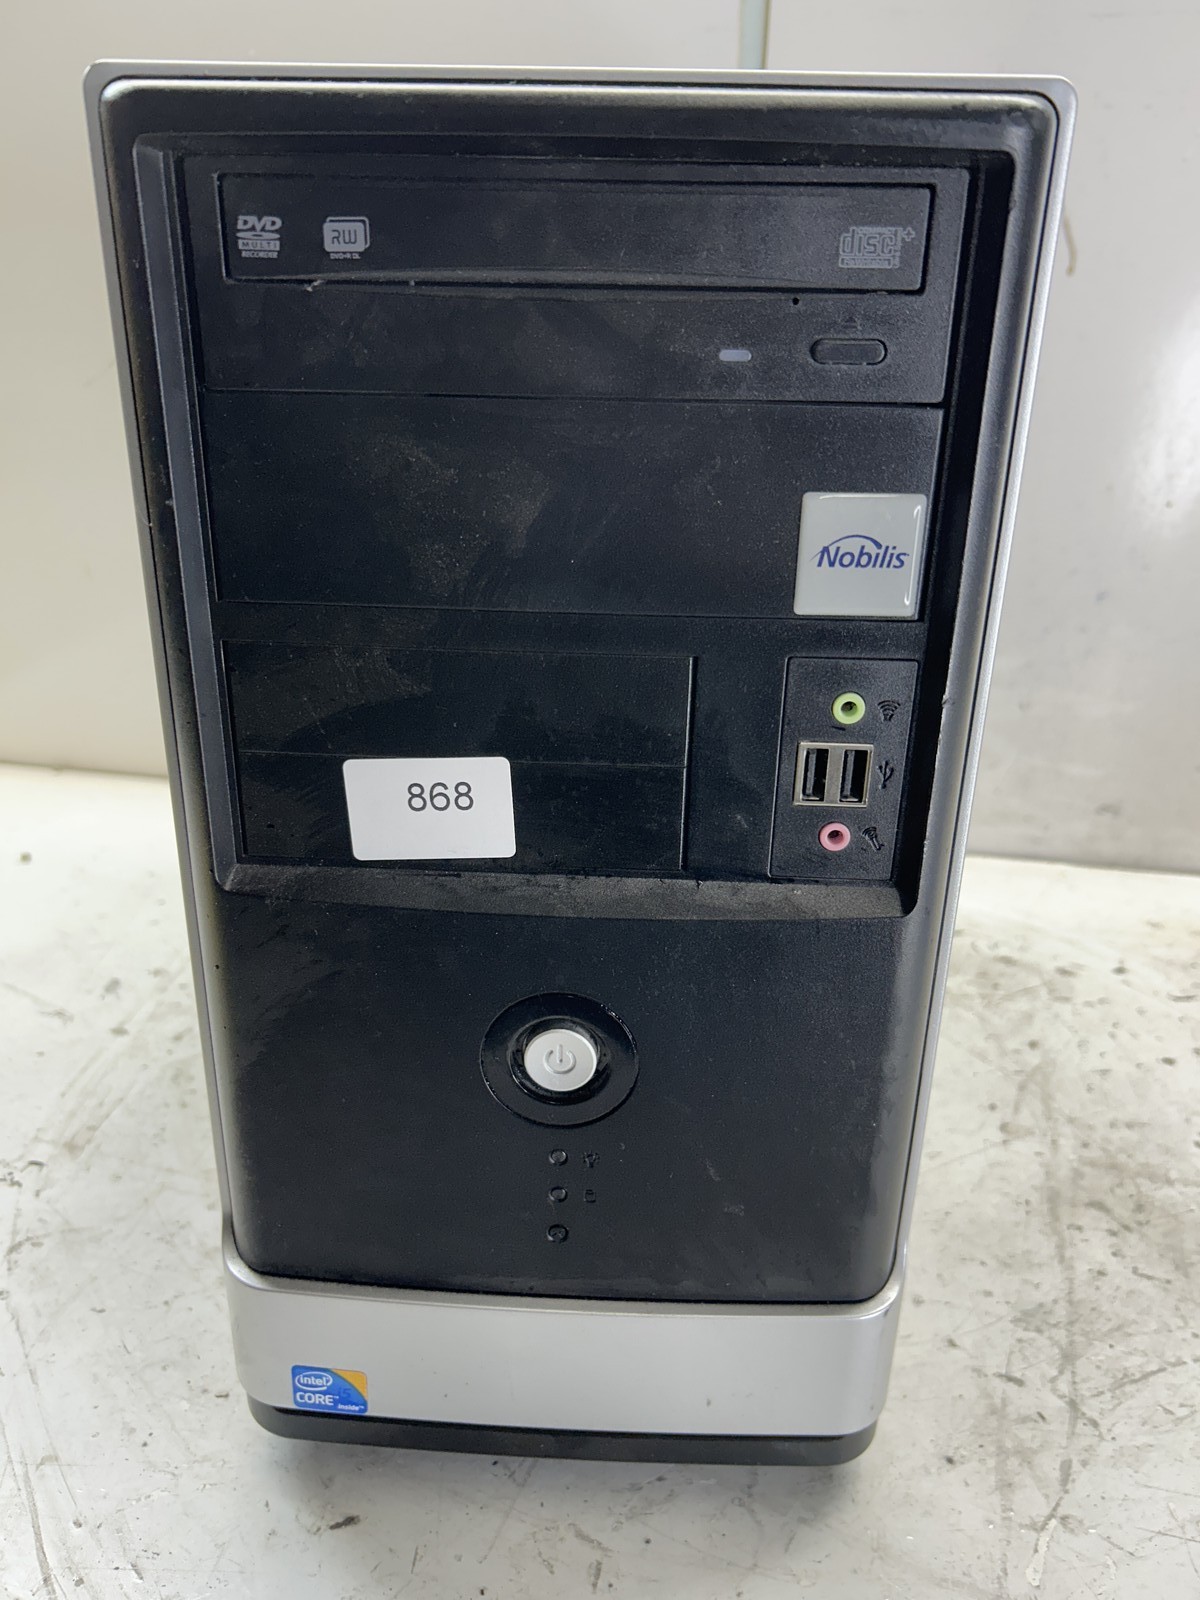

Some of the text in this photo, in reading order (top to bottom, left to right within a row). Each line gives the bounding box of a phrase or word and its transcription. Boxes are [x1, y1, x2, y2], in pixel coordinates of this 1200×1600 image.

[237, 215, 282, 232] DVD
[241, 241, 278, 249] MULTI
[331, 229, 358, 245] RW
[816, 544, 910, 569] Nobilis
[407, 781, 474, 812] 868
[300, 1374, 328, 1386] intel
